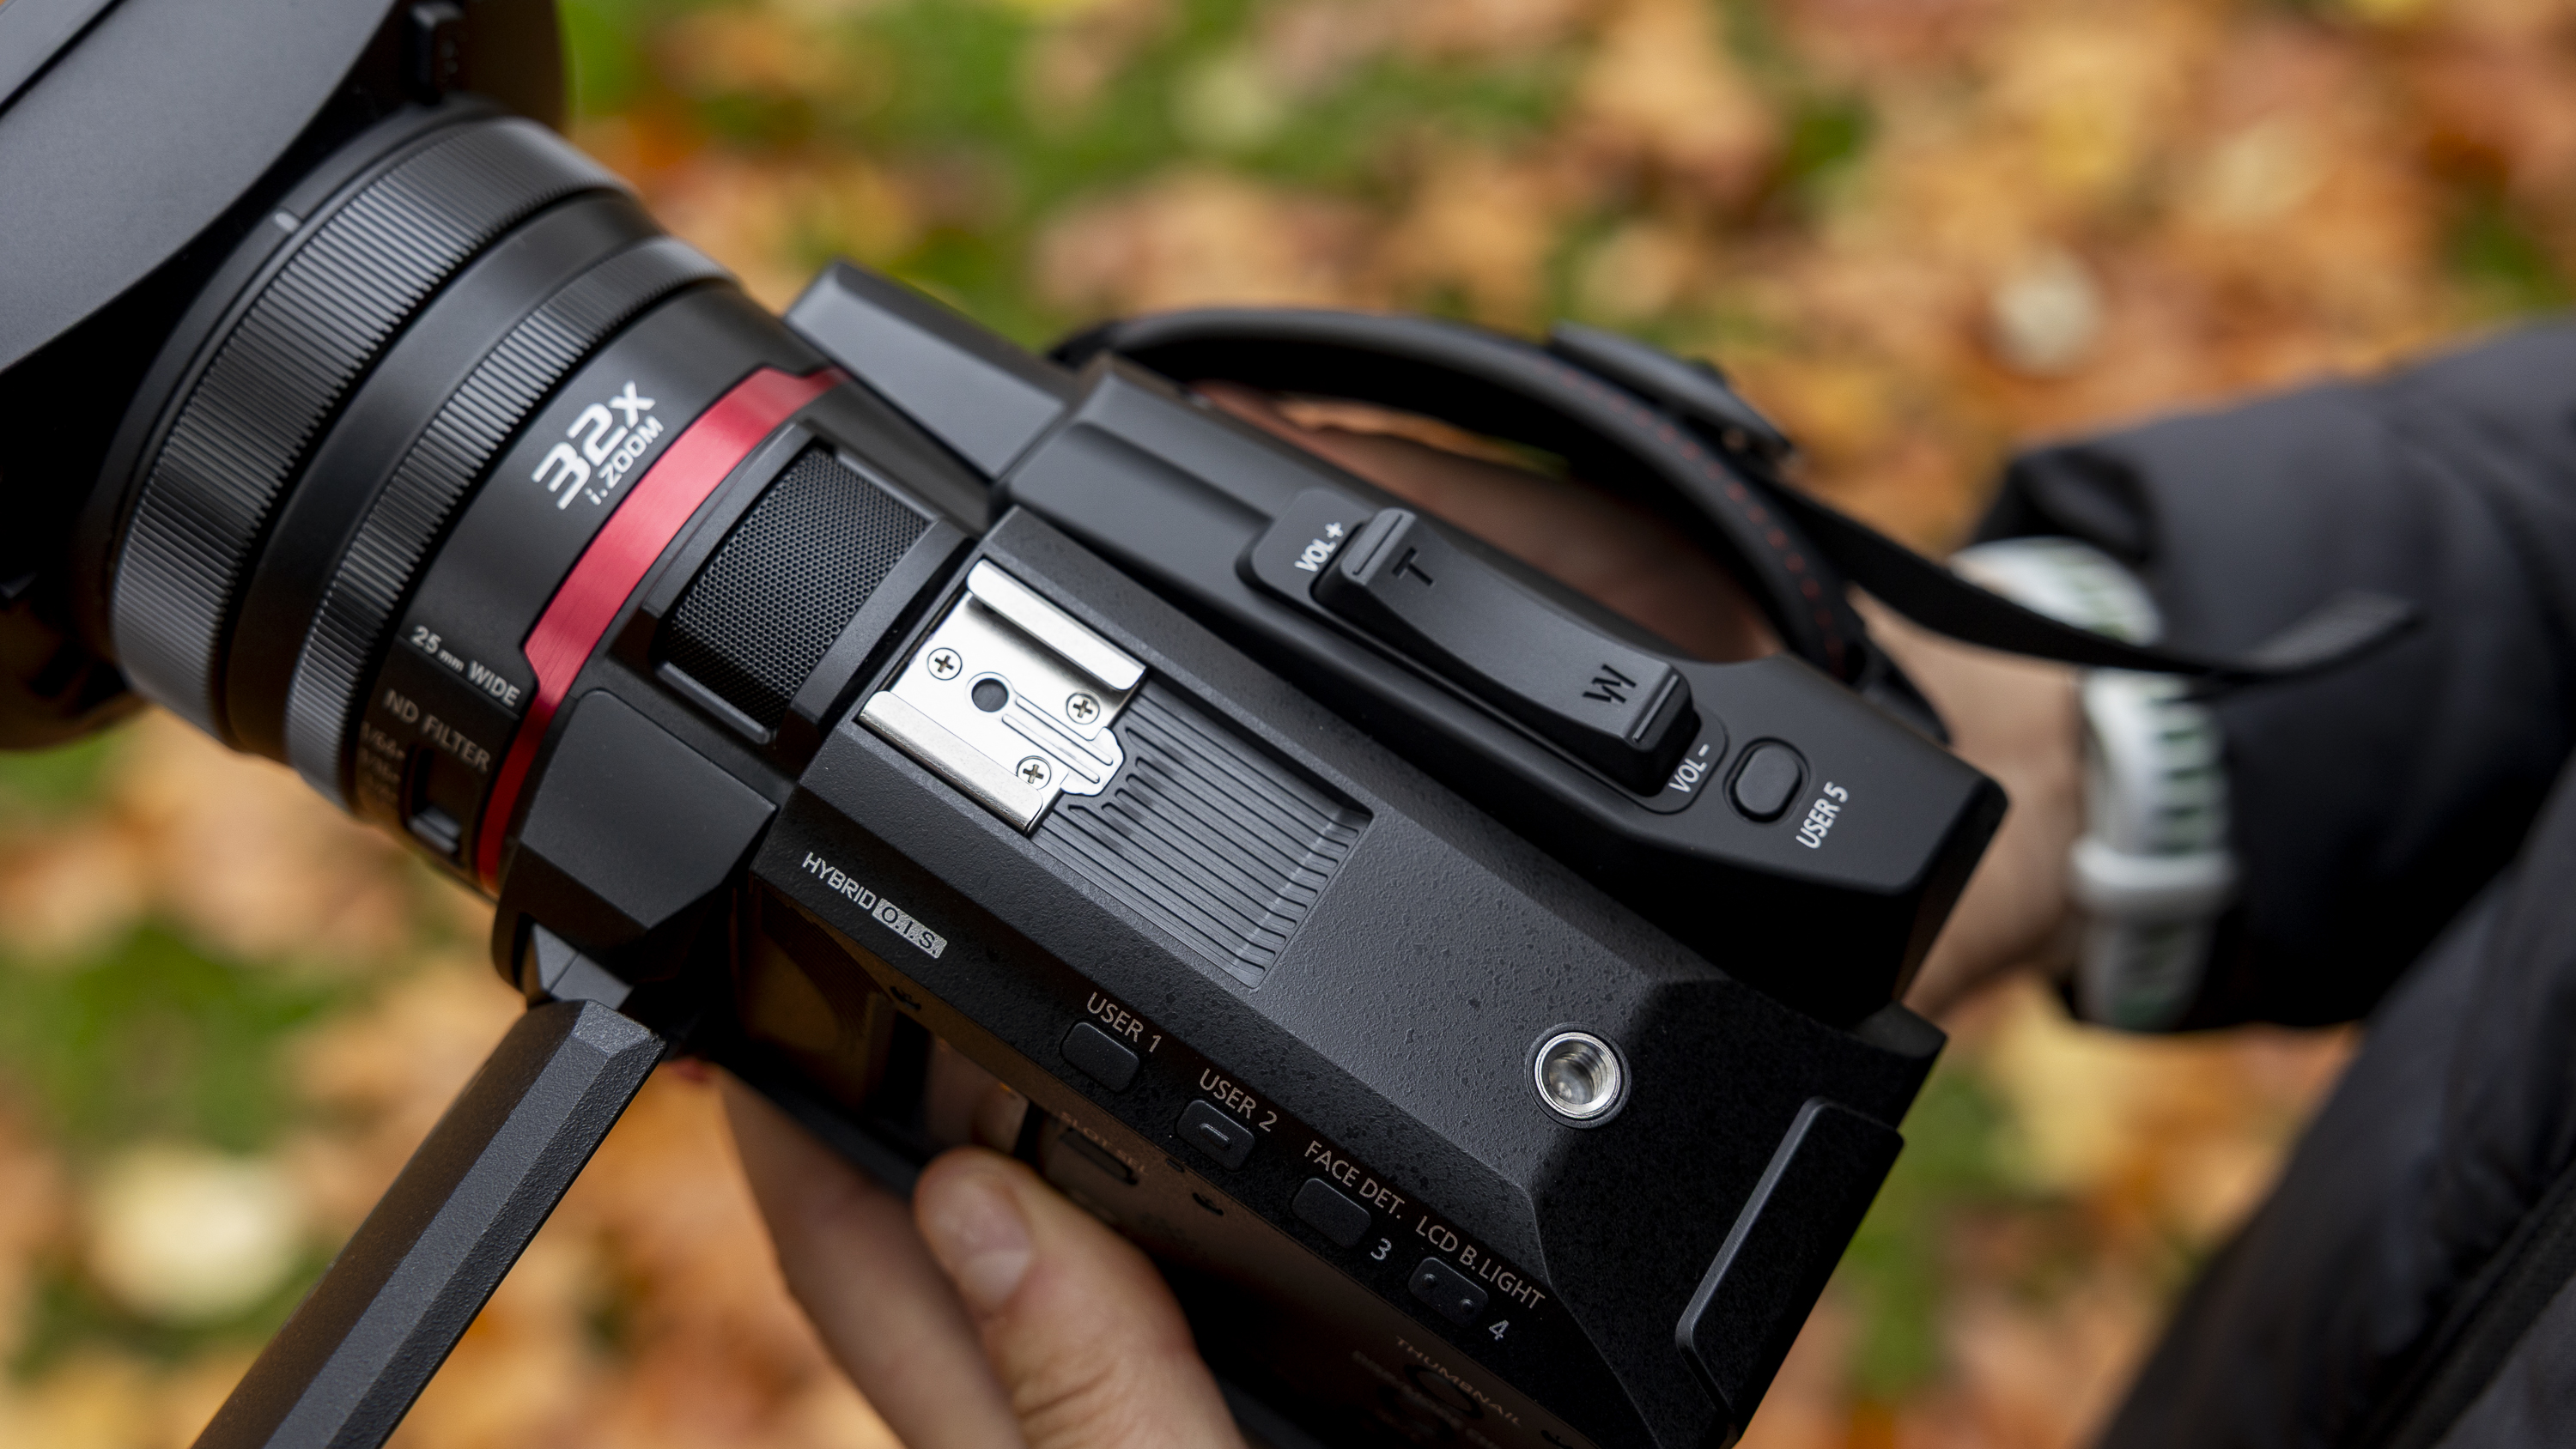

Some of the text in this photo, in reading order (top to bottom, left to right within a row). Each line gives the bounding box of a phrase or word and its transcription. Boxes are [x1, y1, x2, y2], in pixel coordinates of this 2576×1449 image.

[584, 415, 664, 506] i.ZOOM
[1391, 546, 1437, 587] T
[410, 625, 520, 707] 25 mm WIDE
[1582, 664, 1637, 704] W
[383, 688, 420, 724] ND
[420, 713, 491, 773] FILTER
[1795, 781, 1849, 849] USER 5
[802, 852, 938, 955] HYBRID O.I.S.
[1086, 991, 1162, 1053] USER 1
[1199, 1068, 1278, 1132] USER 2
[1303, 1140, 1406, 1220] FACE DET.
[1370, 1238, 1392, 1260] 3
[1415, 1216, 1459, 1252] LCD
[1488, 1319, 1510, 1341] 4
[1396, 1335, 1522, 1428] THUMBNAIL
